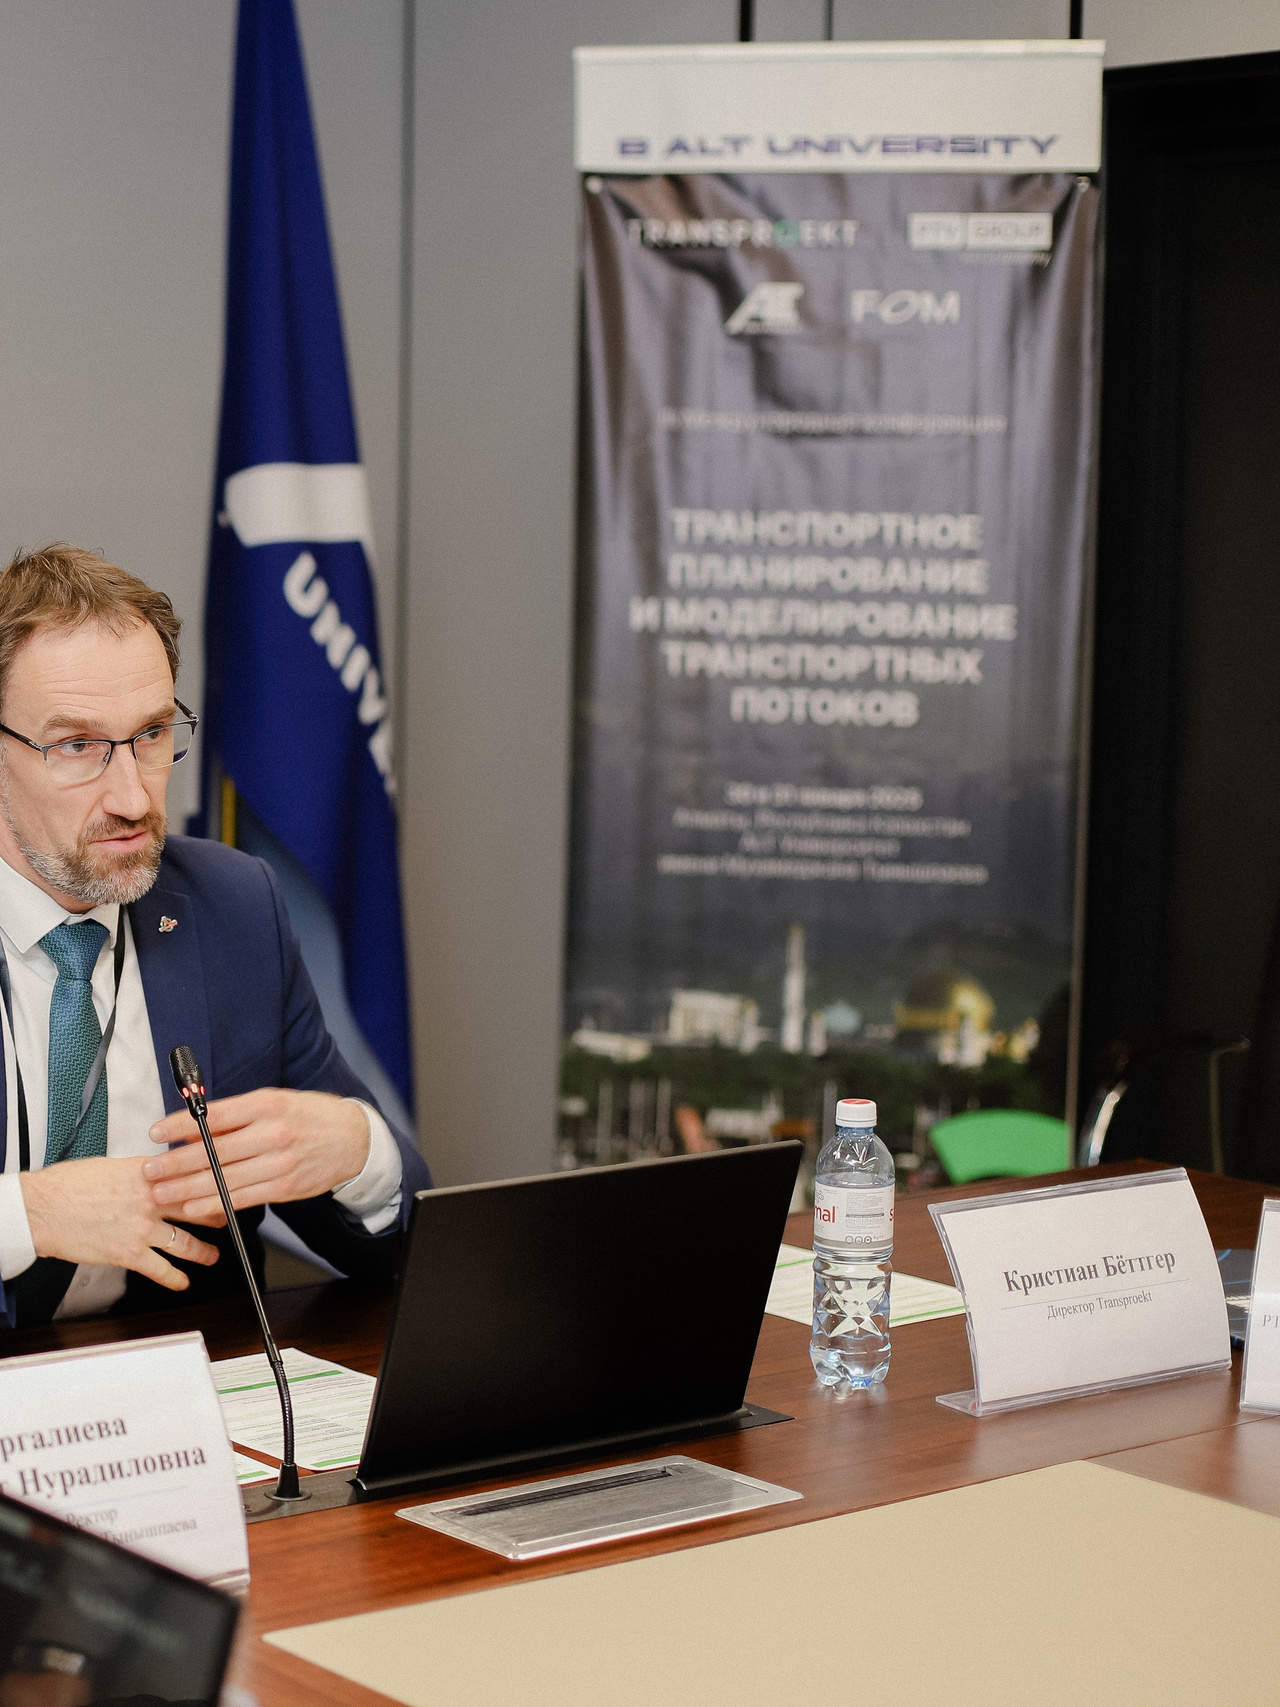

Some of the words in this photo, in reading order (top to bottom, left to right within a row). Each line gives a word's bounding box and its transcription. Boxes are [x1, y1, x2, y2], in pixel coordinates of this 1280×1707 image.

[666, 136, 753, 156] ALT
[766, 134, 1058, 155] UNIVERSITY
[628, 218, 859, 249] TRANSPROEKT
[672, 508, 983, 550] ТРАНСПОРТНОЕ
[668, 553, 988, 596] ПЛАНИРОВАНИЕ
[629, 595, 659, 633] И
[664, 596, 1018, 640] МОДЕЛИРОВАНИЕ
[661, 640, 984, 684] ТРАНСПОРТНЫХ
[730, 686, 920, 728] ПОТОКОВ
[1003, 1268, 1099, 1296] Кристиан
[1101, 1252, 1176, 1277] Бёттгер
[1046, 1302, 1095, 1320] Директор
[1096, 1290, 1153, 1310] Transproekt
[18, 1446, 206, 1499] Нурадиловна
